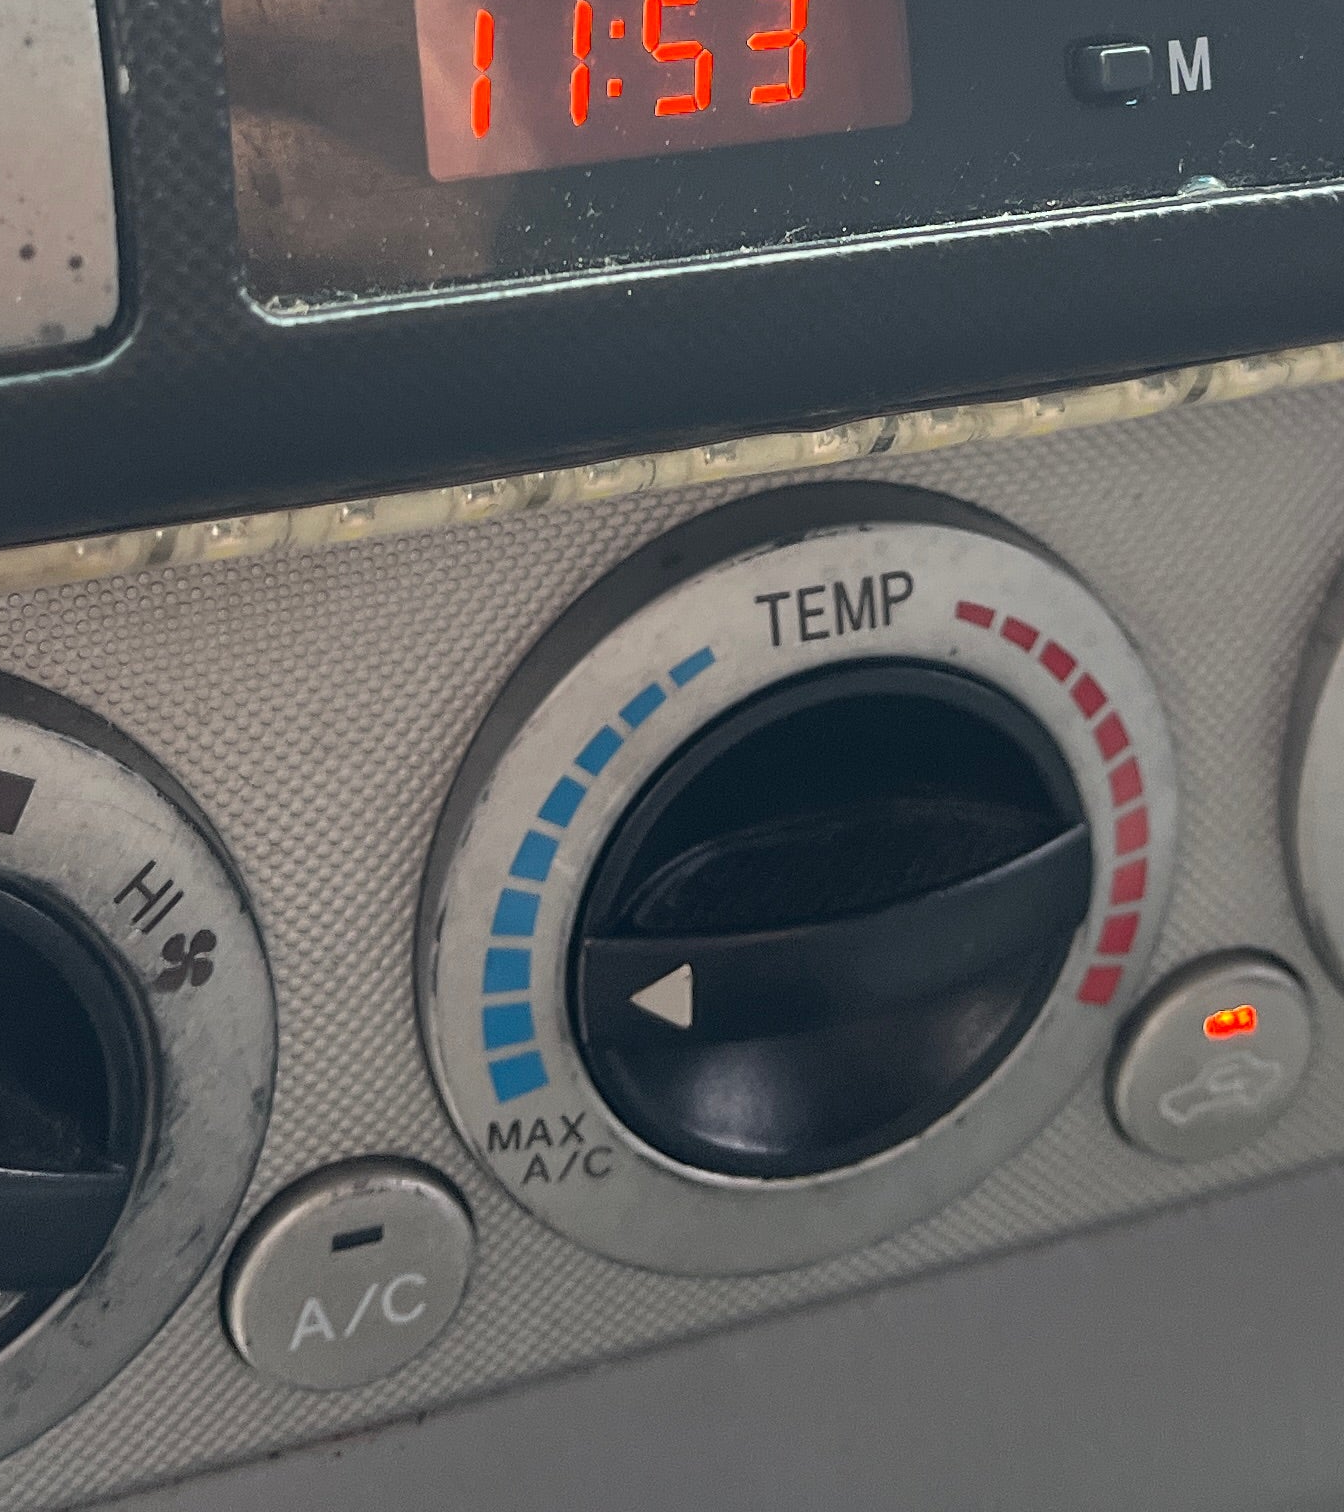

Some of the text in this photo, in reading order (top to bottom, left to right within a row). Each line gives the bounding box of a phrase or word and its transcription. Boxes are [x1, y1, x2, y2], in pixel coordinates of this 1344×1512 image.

[1167, 35, 1212, 95] M
[755, 569, 915, 647] TEMP
[113, 859, 187, 935] HI
[486, 1110, 590, 1156] MAX
[521, 1144, 616, 1186] A/C
[287, 1273, 429, 1352] A/C
